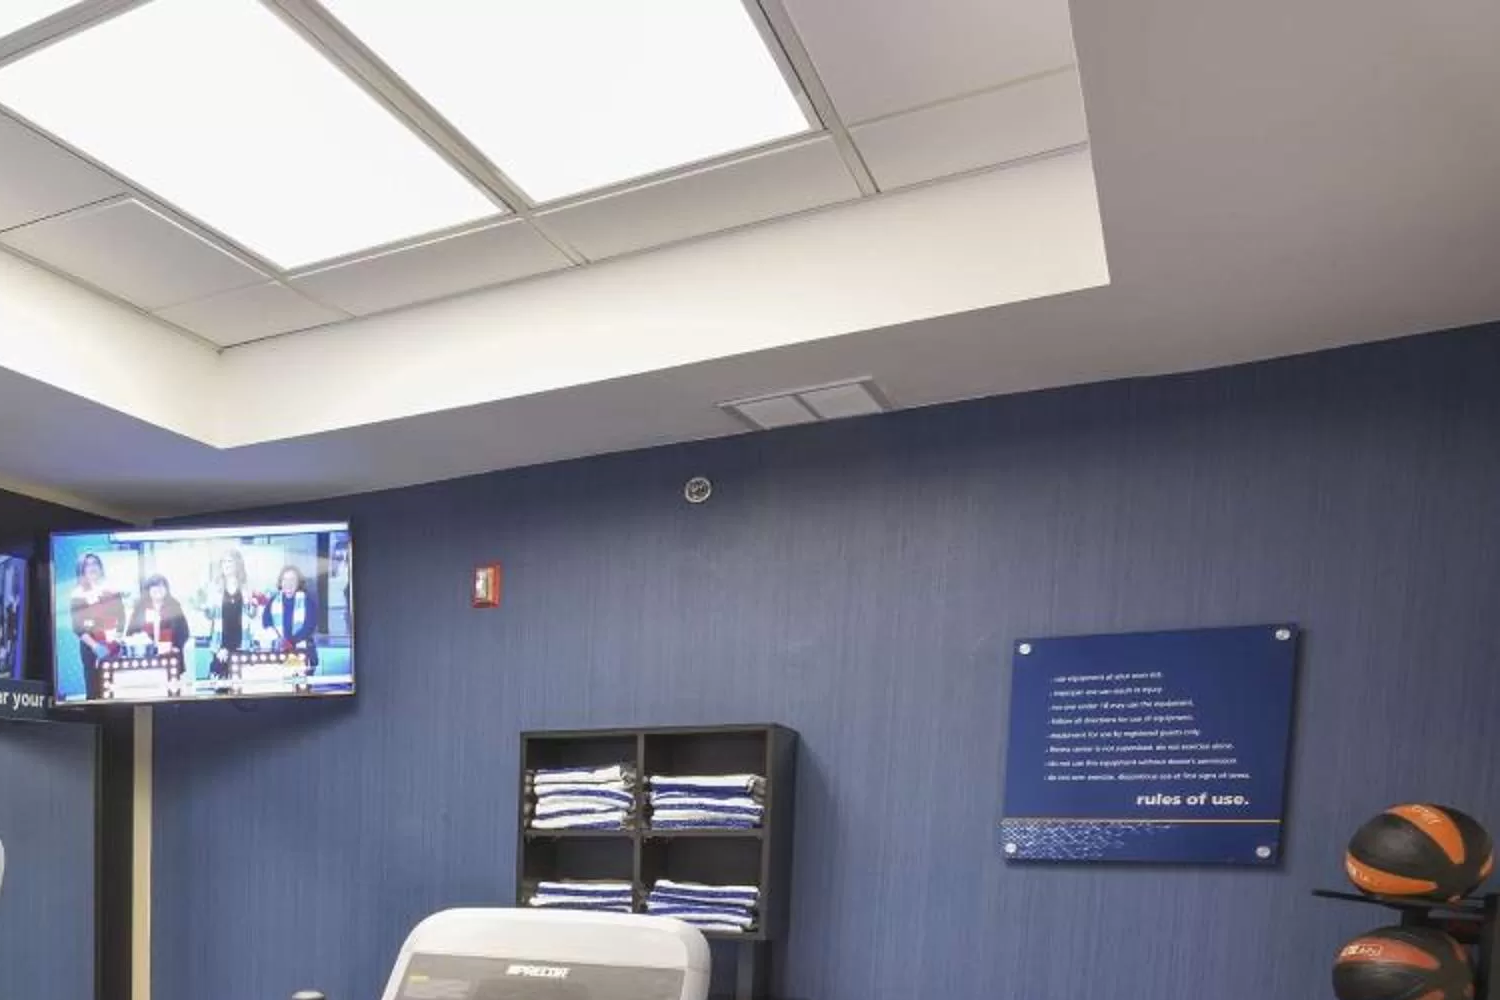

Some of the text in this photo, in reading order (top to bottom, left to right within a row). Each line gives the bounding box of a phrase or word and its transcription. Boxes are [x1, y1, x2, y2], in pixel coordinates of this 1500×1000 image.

[12, 692, 45, 711] your
[1136, 791, 1249, 806] rules of use.
